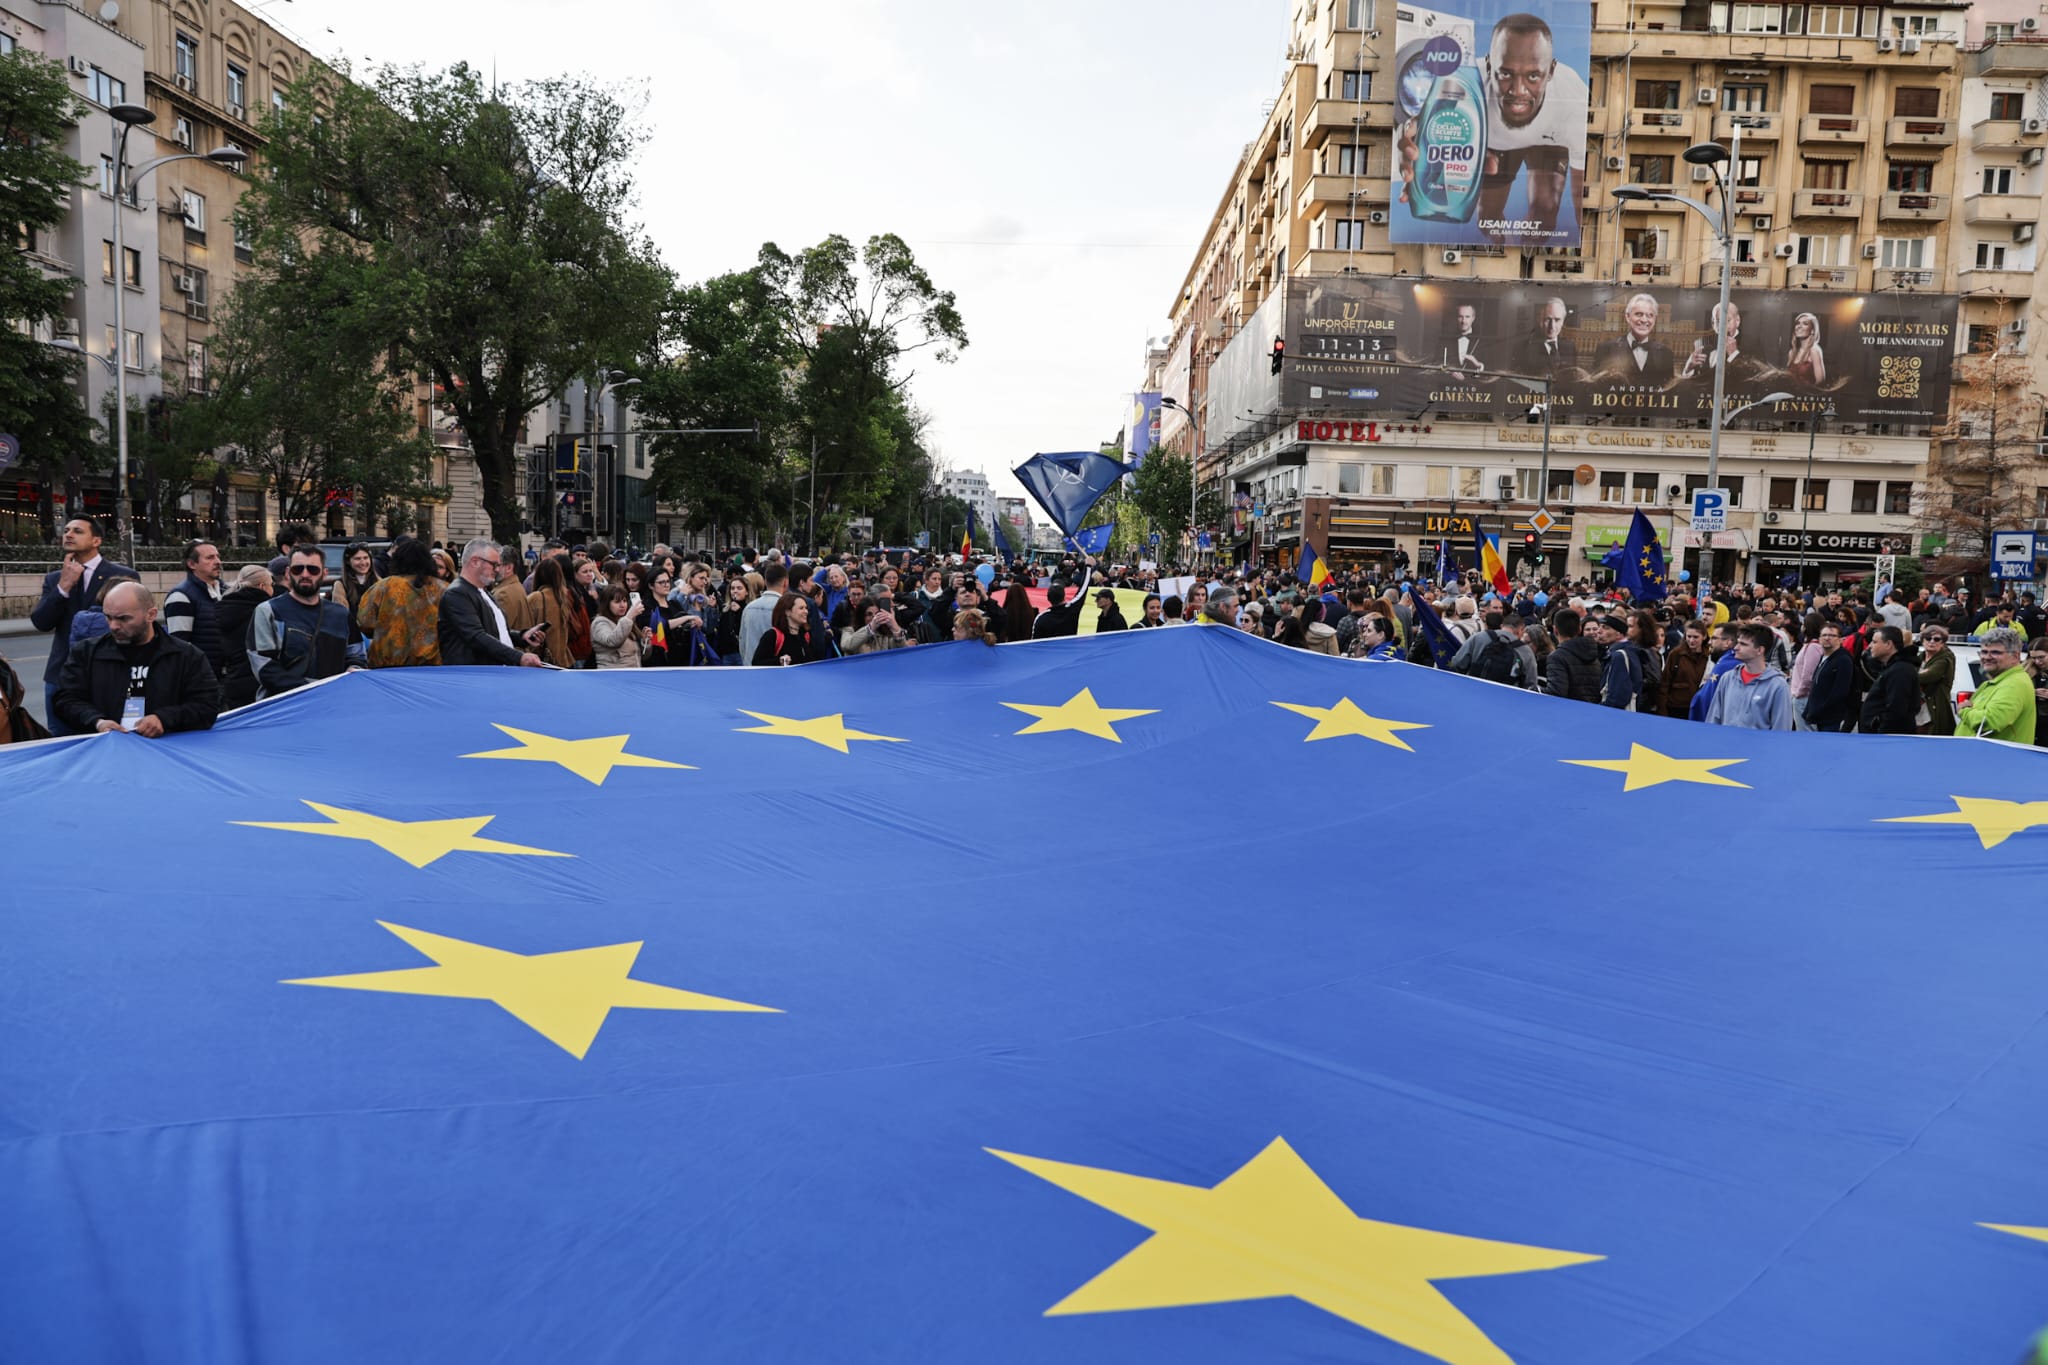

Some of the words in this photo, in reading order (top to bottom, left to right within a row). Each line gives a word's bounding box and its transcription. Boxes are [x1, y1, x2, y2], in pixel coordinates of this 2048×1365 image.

[1426, 51, 1458, 62] NOU
[1428, 144, 1474, 161] DERO
[1446, 163, 1468, 172] PRO
[1478, 219, 1512, 229] USAIN
[1513, 220, 1542, 230] BOLT
[1304, 318, 1395, 330] UNFORGETTABLE
[1860, 322, 1901, 334] MORE
[1905, 323, 1949, 335] STARS
[1862, 336, 1875, 345] TO
[1876, 337, 1889, 345] BE
[1889, 337, 1944, 347] ANNOUNCED
[1307, 352, 1390, 361] SEPTEMBRIE
[1609, 385, 1664, 393] ANDREA
[1592, 393, 1679, 409] BOCELLI
[1774, 400, 1836, 413] JENKINS
[1298, 420, 1381, 442] HOTEL
[1752, 439, 1777, 447] HOTEL
[1426, 516, 1472, 532] LUCA
[1767, 533, 1813, 546] TED'S
[1818, 535, 1876, 548] COFFEE
[2000, 563, 2030, 577] TAXI
